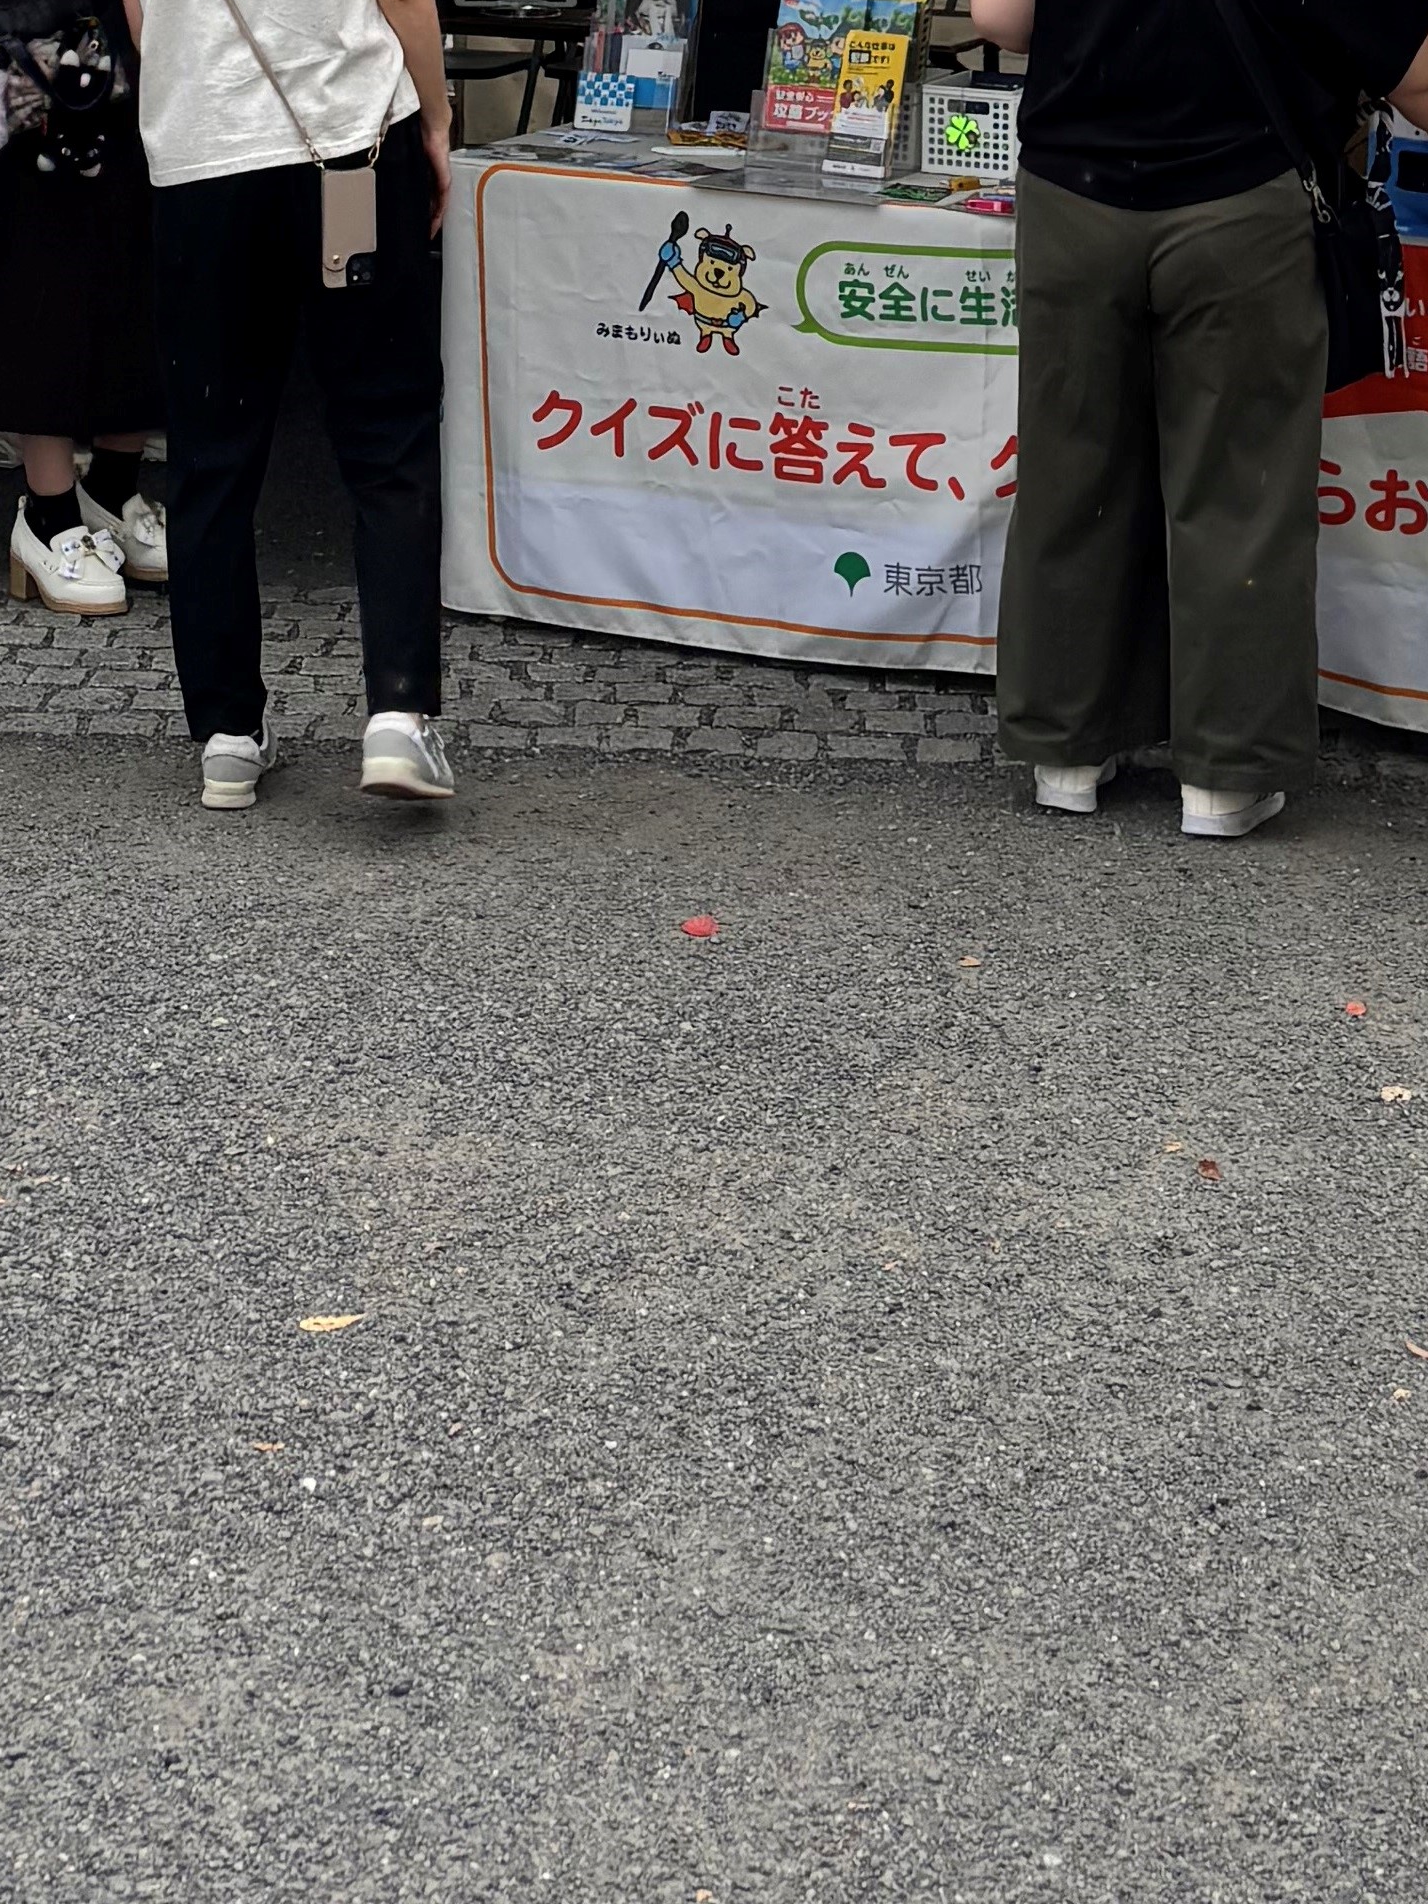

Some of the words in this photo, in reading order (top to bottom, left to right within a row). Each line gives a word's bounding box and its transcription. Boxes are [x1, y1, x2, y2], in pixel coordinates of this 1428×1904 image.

[774, 103, 835, 122] 攻略ブッ
[883, 562, 983, 597] 東京都
